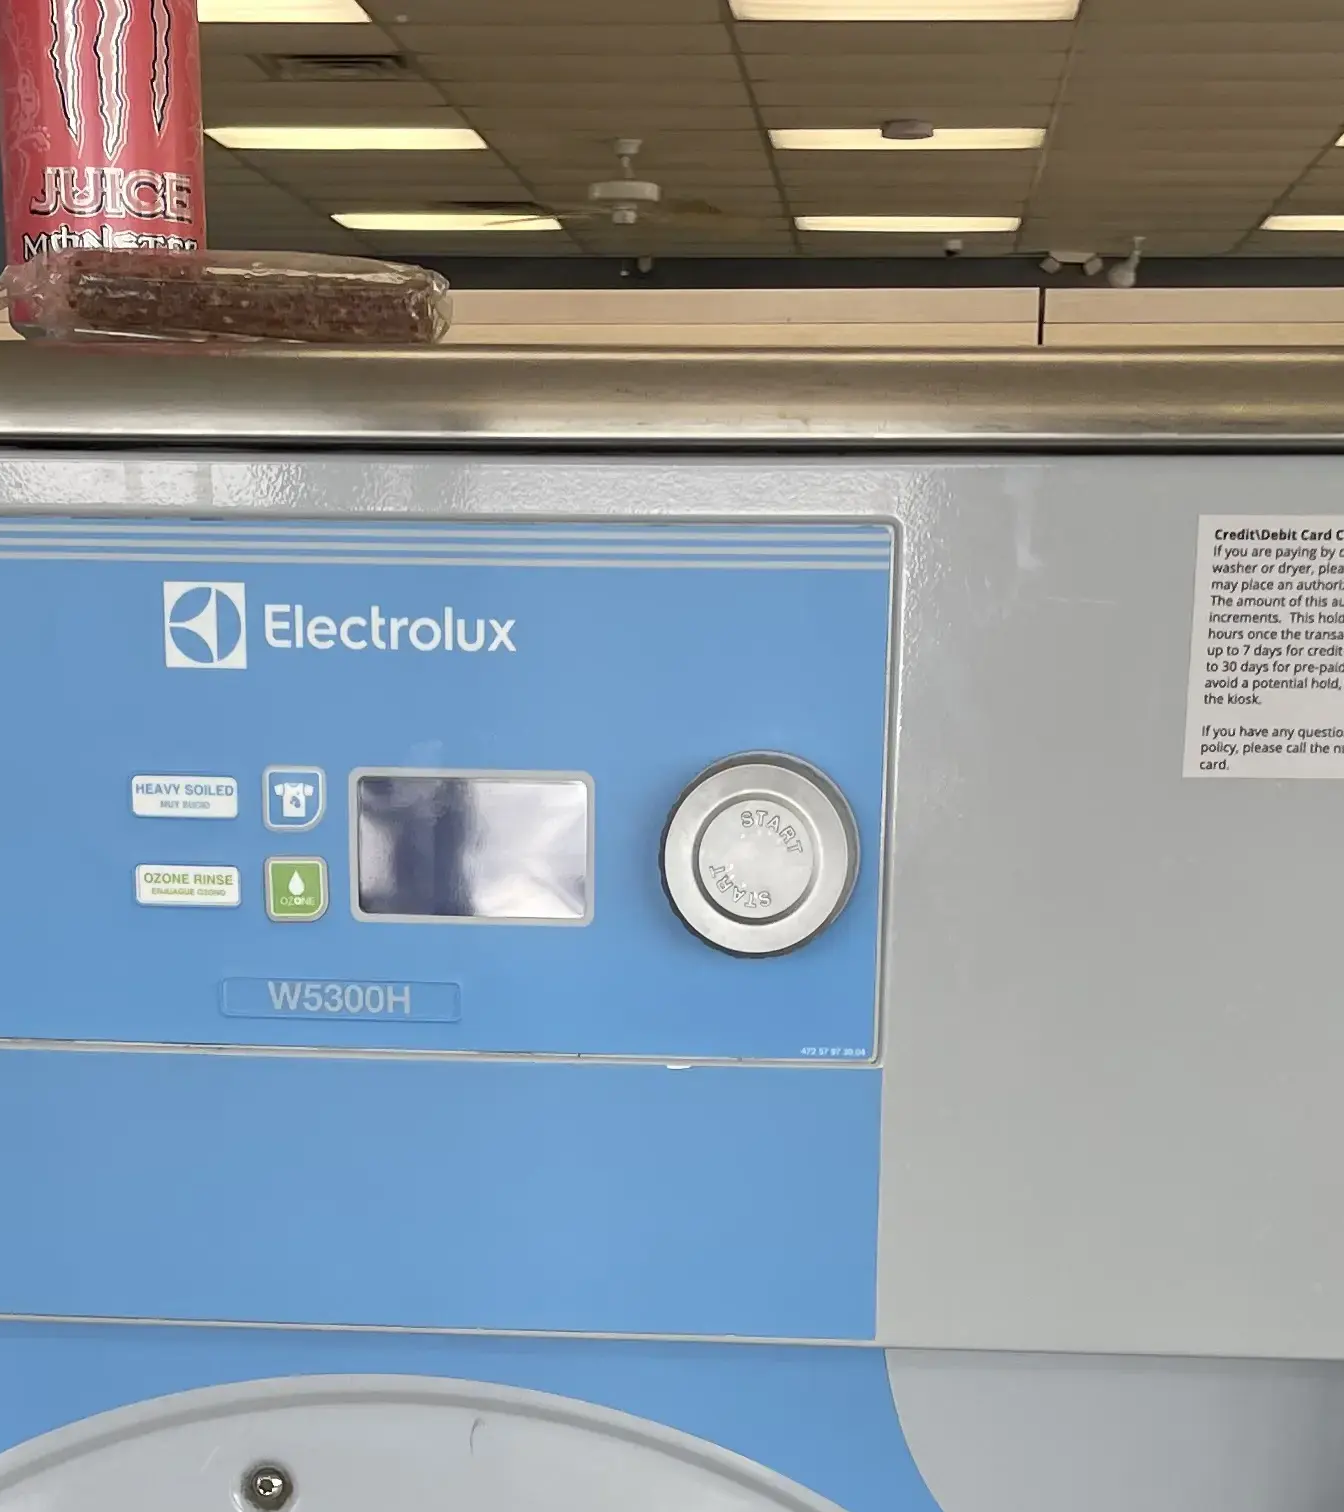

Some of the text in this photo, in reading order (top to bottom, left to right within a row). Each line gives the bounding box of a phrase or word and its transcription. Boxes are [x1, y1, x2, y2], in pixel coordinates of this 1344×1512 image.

[29, 166, 193, 224] JUICE
[1301, 529, 1332, 541] Card
[1213, 545, 1222, 557] If
[1225, 546, 1247, 559] you
[1252, 547, 1271, 558] are
[1275, 546, 1317, 560] paying
[1320, 546, 1336, 560] by
[1212, 562, 1258, 574] washer
[1261, 564, 1274, 574] or
[1278, 562, 1314, 577] dryer,
[265, 604, 517, 652] Electrolux
[1207, 646, 1223, 658] up
[1227, 646, 1239, 656] to
[1243, 645, 1250, 656] 7
[1254, 645, 1282, 659] days
[1286, 644, 1304, 656] for
[1308, 645, 1343, 656] credit
[1207, 662, 1218, 672] to
[1222, 661, 1237, 672] 30
[1240, 661, 1268, 675] days
[1273, 661, 1290, 673] for
[1204, 693, 1262, 705] the kiosk.
[1202, 725, 1210, 737] If
[1213, 727, 1235, 739] you
[1239, 726, 1268, 737] have
[1272, 728, 1294, 740] any
[1201, 742, 1238, 756] policy,
[1242, 742, 1282, 755] please
[1286, 742, 1306, 754] call
[1310, 742, 1329, 754] the
[1200, 759, 1229, 770] card.
[135, 783, 234, 796] HEAVY SOILED
[740, 810, 803, 855] START
[144, 873, 234, 885] OZONE RINSE
[709, 865, 771, 908] START
[280, 897, 315, 906] OZONE
[268, 981, 410, 1014] W5300H
